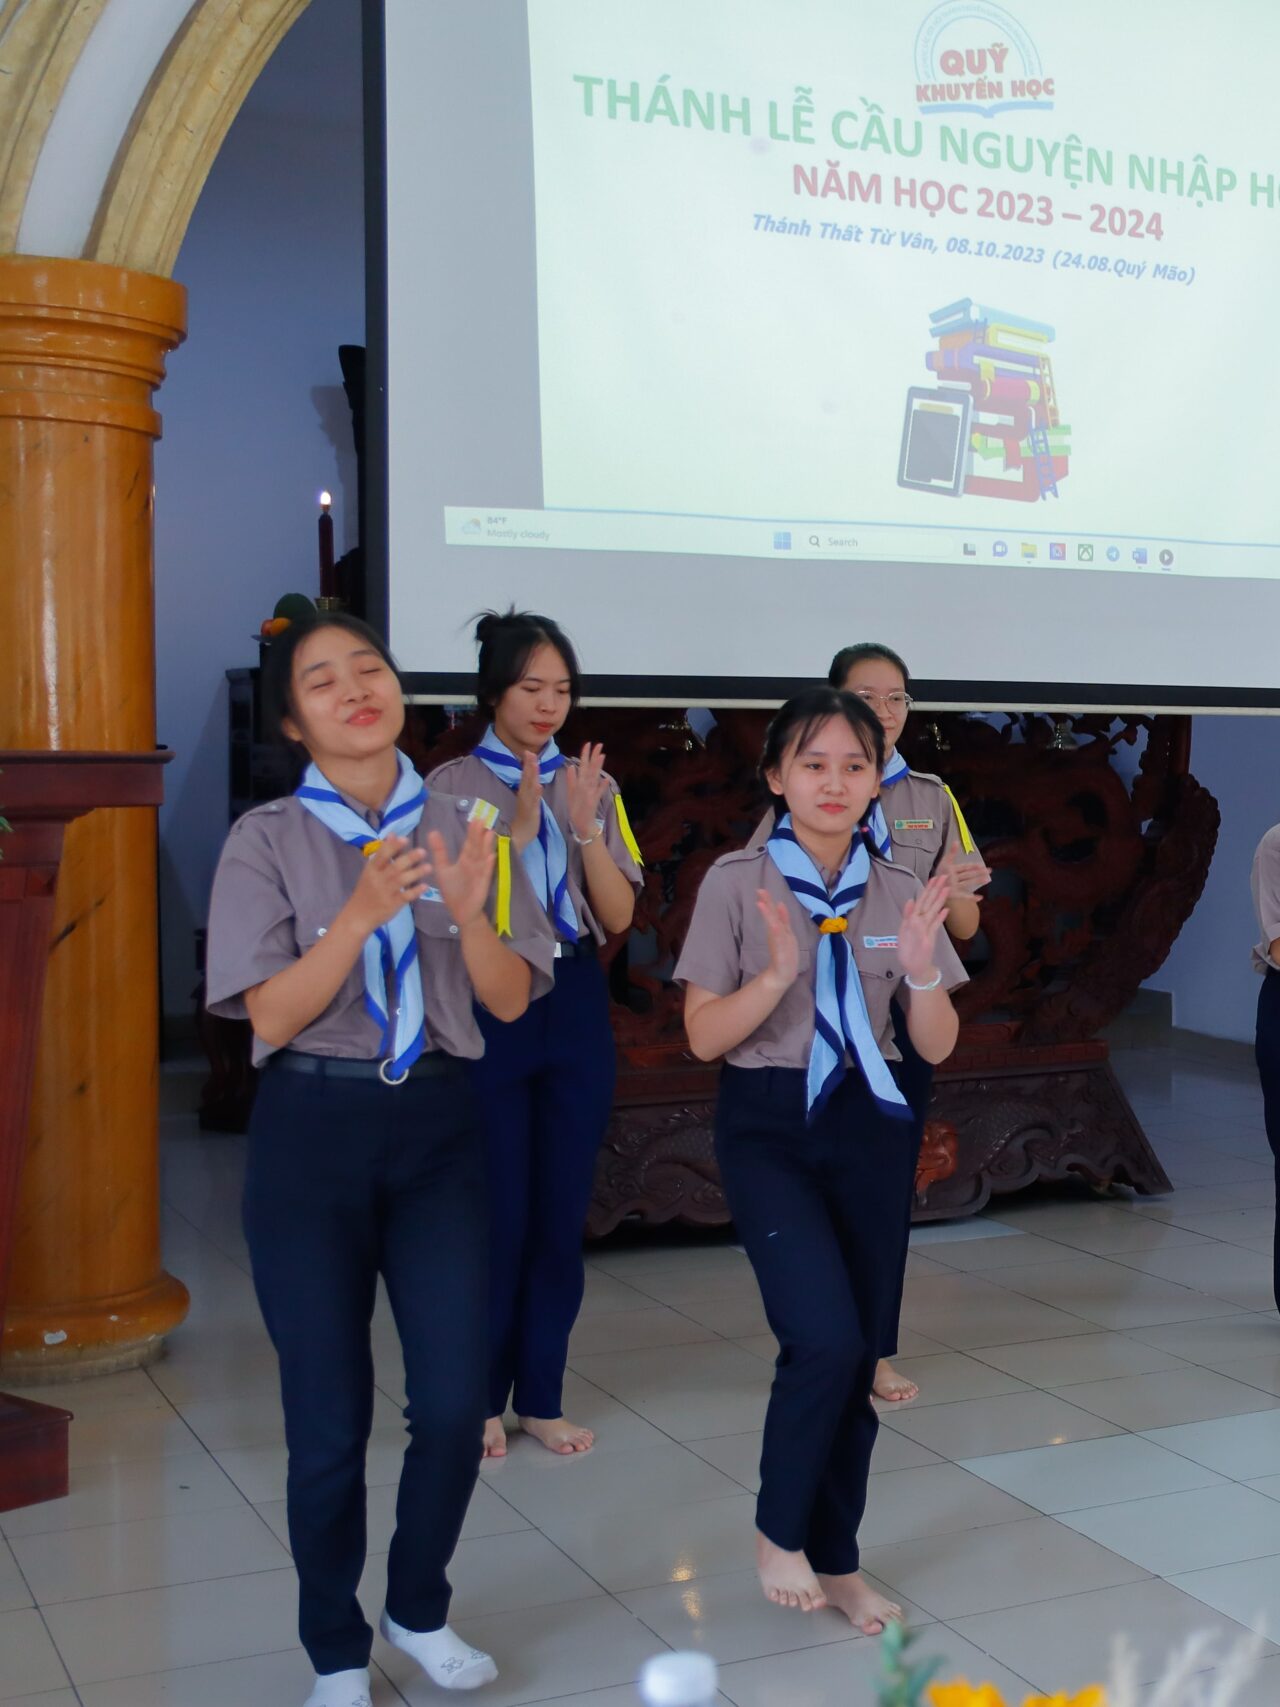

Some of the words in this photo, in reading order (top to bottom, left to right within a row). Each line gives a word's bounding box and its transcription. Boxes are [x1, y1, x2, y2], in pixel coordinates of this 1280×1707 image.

[940, 42, 1009, 76] QUỸ
[916, 76, 1003, 102] KHUYẾN
[1011, 78, 1055, 100] HỌC
[573, 74, 751, 136] THÁNH
[768, 86, 815, 144] LỄ
[831, 97, 923, 157] CẦU
[939, 125, 1113, 189] NGUYỆN
[1128, 153, 1237, 207] NHẬP
[793, 159, 881, 204] NĂM
[894, 176, 968, 218] HỌC
[977, 187, 1054, 226] 2023
[1089, 204, 1164, 241] 2024
[752, 213, 811, 237] Thánh
[819, 222, 864, 243] Thất
[870, 228, 896, 246] Từ
[900, 231, 938, 254] Vân,
[946, 237, 1045, 264] 08.10.2023
[1052, 250, 1147, 280] (24.08.Quý
[1152, 263, 1195, 286] Mão)
[828, 536, 858, 547] Search
